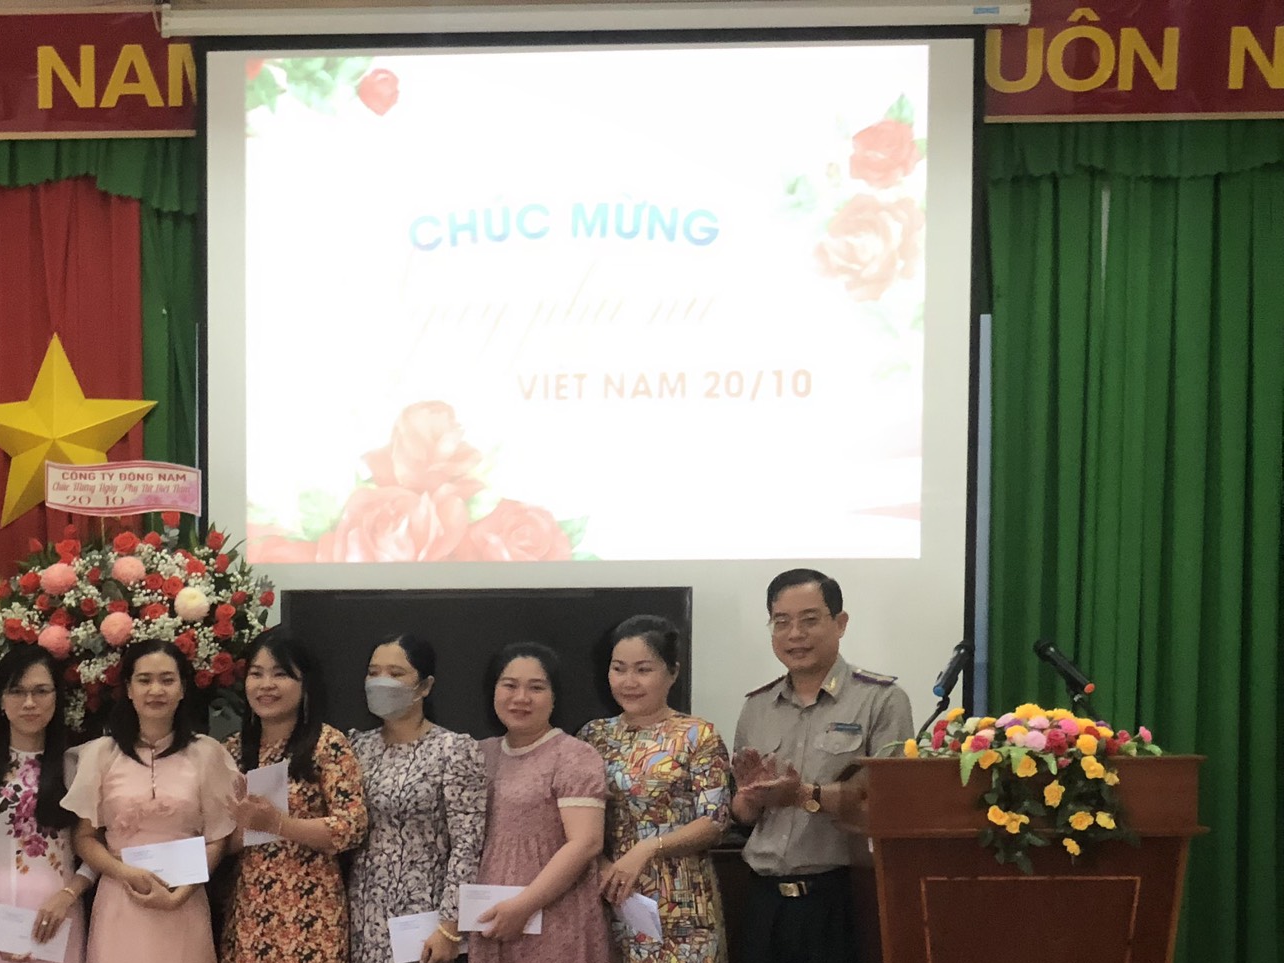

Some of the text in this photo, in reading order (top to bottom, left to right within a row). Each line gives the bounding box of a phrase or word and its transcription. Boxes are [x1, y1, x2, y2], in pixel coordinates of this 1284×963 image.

[409, 192, 720, 252] CHÚC MỪNG
[603, 370, 688, 400] NAM
[702, 367, 813, 402] 20/10
[101, 472, 115, 481] TY
[158, 473, 187, 482] NAM
